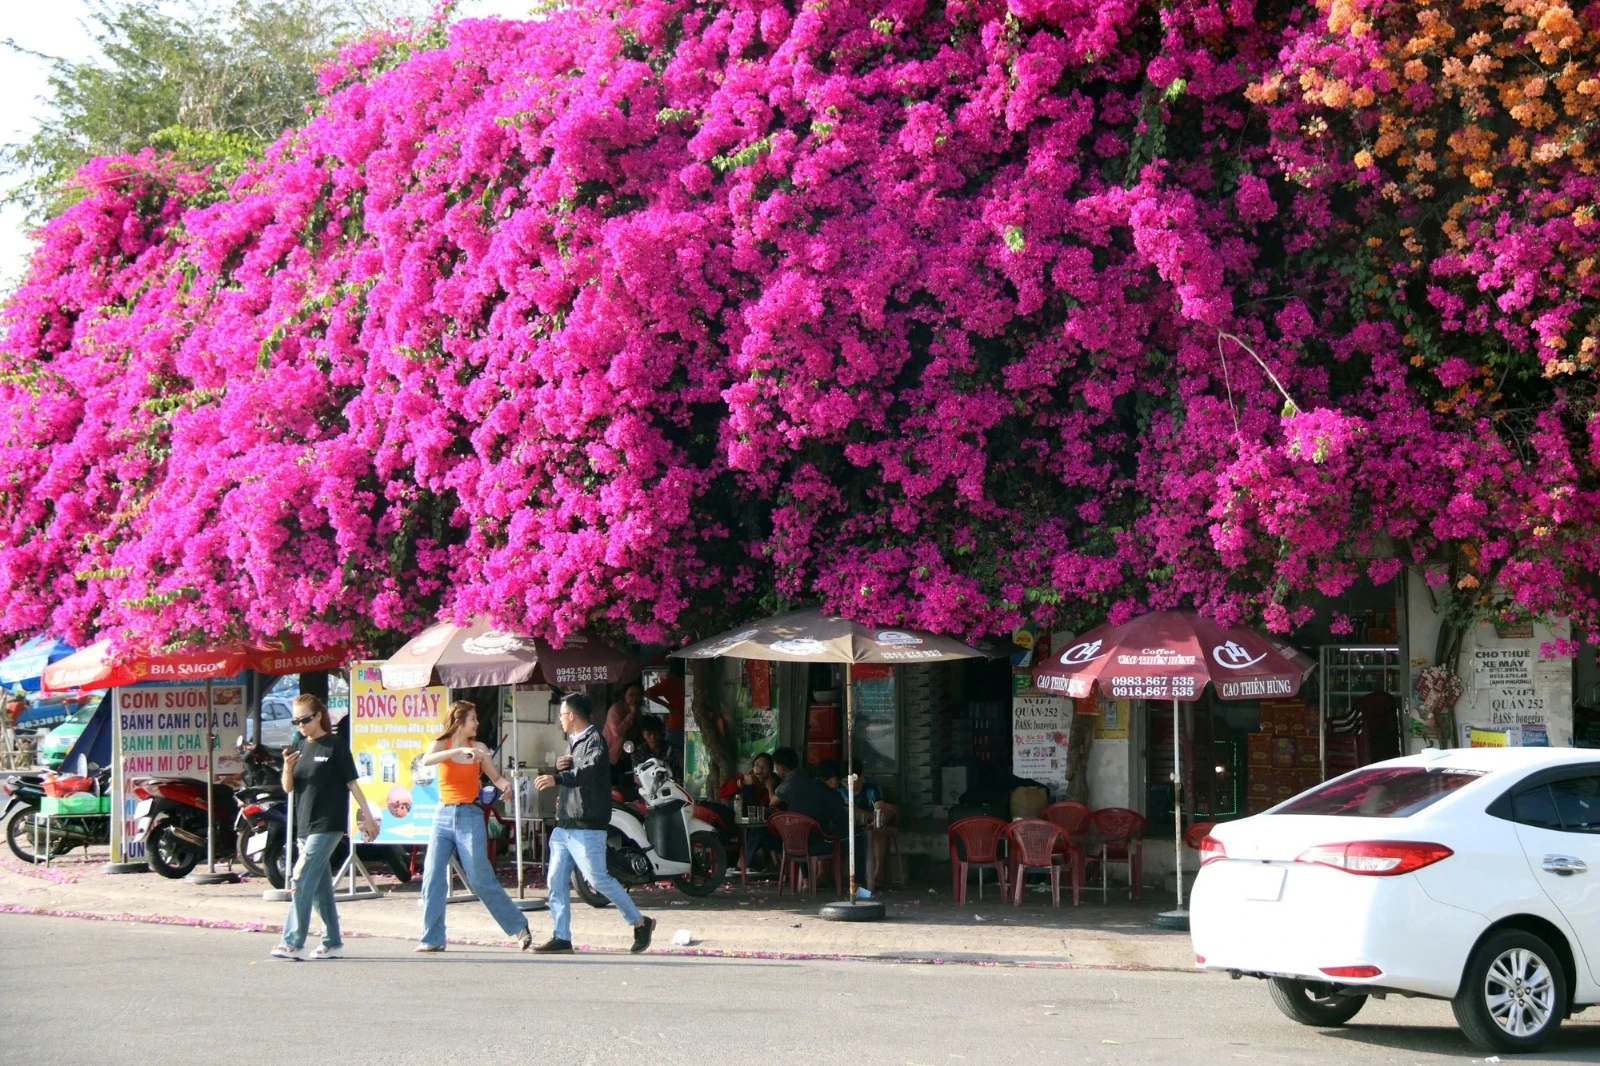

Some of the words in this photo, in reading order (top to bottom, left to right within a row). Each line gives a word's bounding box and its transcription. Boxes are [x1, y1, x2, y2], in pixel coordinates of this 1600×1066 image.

[1118, 655, 1139, 665] CAO
[1475, 651, 1499, 659] CHO
[1501, 649, 1531, 658] THUÊ
[275, 658, 293, 669] BIA
[295, 654, 335, 667] SAIGON
[1482, 660, 1497, 668] XE
[1499, 658, 1524, 668] MÁY
[151, 664, 175, 674] BIA
[556, 666, 591, 675] 0942.574
[557, 675, 576, 683] 0972
[1037, 675, 1050, 689] CAO
[1111, 676, 1168, 686] 0983.867
[1171, 676, 1195, 686] 535
[1112, 686, 1168, 696] 0918.867
[1171, 686, 1195, 696] 535
[1223, 683, 1239, 696] CAO
[1266, 676, 1291, 694] HÙNG
[1502, 688, 1536, 696] WIFI
[121, 691, 158, 709] CƠM
[165, 688, 208, 708] SƯỜN
[356, 687, 397, 718] BÔNG
[1492, 697, 1525, 711] QUÁN
[1528, 699, 1544, 709] 252
[1015, 705, 1042, 718] QUÁN
[1044, 707, 1058, 717] 252
[121, 711, 153, 730] BÁNH
[158, 713, 190, 729] CANH
[223, 708, 239, 727] CÁ
[122, 732, 153, 751] BÁNH
[158, 731, 173, 751] MÌ
[177, 730, 201, 750] CHẢ
[158, 752, 172, 772] MÌ
